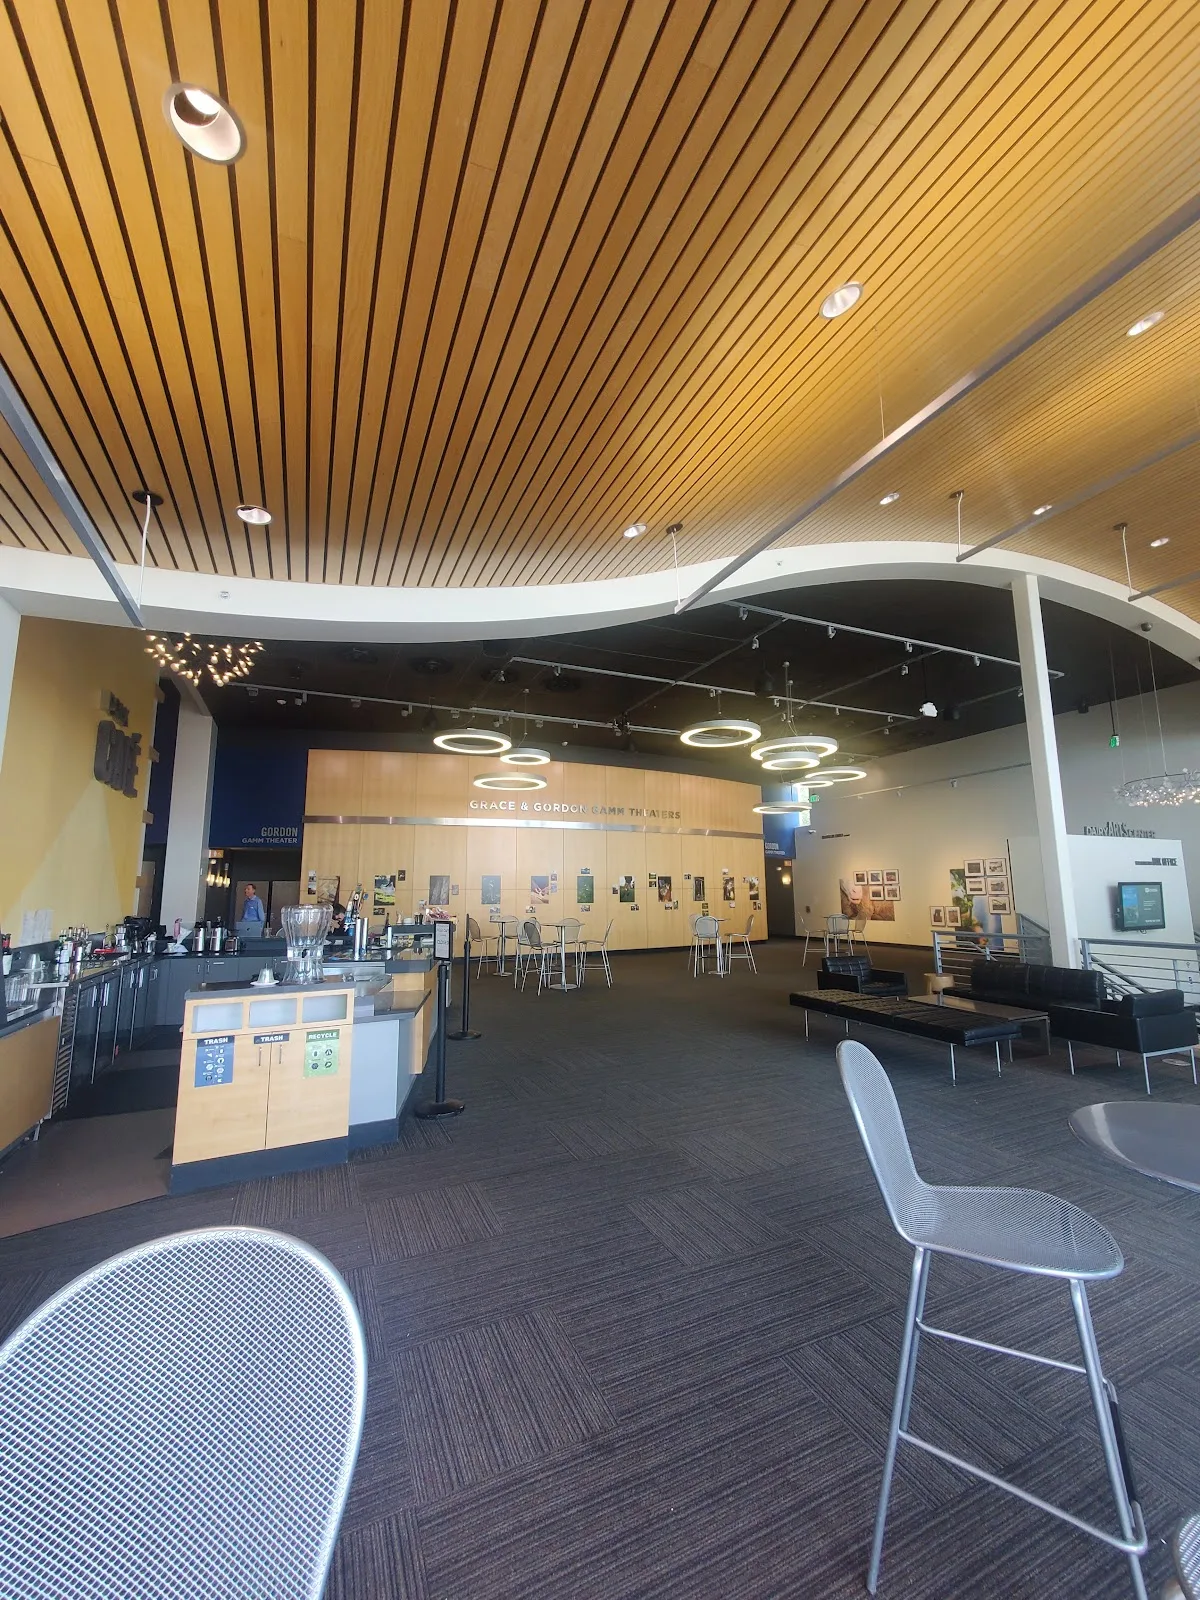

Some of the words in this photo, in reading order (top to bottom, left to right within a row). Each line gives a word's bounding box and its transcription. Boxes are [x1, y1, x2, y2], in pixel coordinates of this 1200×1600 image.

[469, 800, 516, 811] GRACE
[520, 801, 529, 811] &
[533, 802, 588, 814] GORDON
[591, 806, 625, 816] GAMM
[628, 808, 681, 819] THEATERS
[261, 827, 298, 836] GORDON
[260, 1034, 284, 1043] TRASH
[308, 1032, 337, 1040] RECYCLE
[204, 1037, 228, 1045] TRASH
